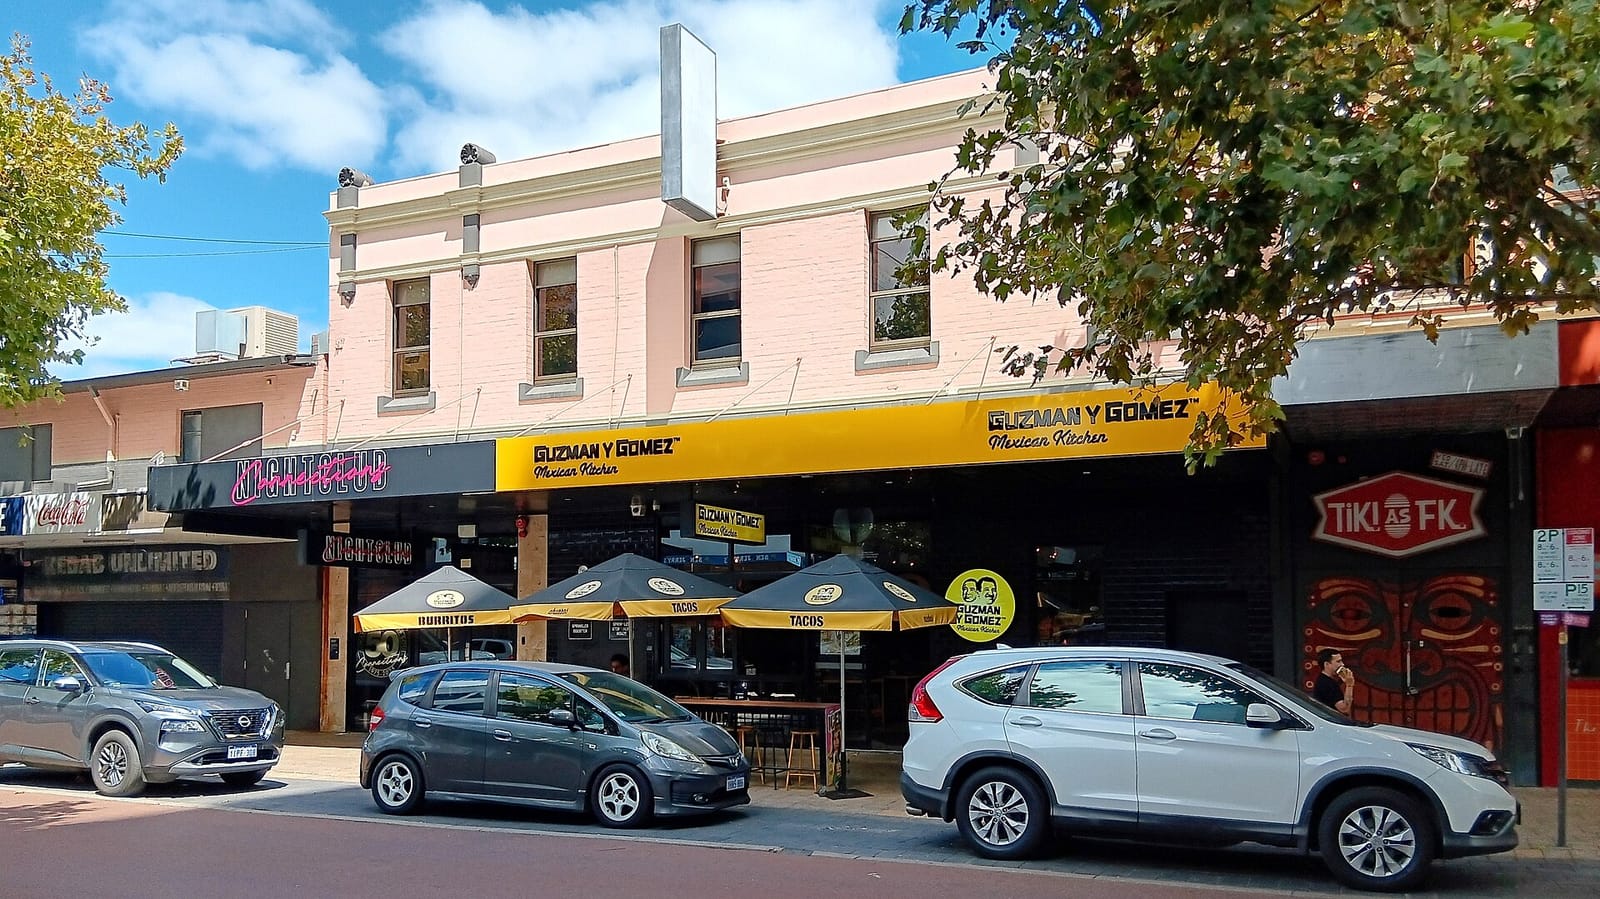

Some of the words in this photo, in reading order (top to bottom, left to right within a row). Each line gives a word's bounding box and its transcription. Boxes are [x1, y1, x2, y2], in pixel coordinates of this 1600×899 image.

[988, 406, 1081, 431] GUZMAN
[1085, 404, 1101, 425] Y
[989, 434, 1049, 450] Mexican
[1053, 429, 1108, 445] Kitchen
[534, 443, 600, 463] GUZMAN
[602, 441, 614, 458] Y
[534, 465, 577, 479] Mexican
[580, 462, 618, 476] Kitchen
[231, 456, 392, 505] Connections
[698, 505, 729, 524] GUZMAN
[729, 511, 736, 525] Y
[1386, 508, 1411, 524] AS
[1537, 530, 1559, 542] 2P
[110, 550, 217, 573] UNLIMITED
[671, 602, 698, 613] TACOS
[957, 605, 1000, 615] GUZMAN
[418, 615, 474, 626] BURRITOS
[790, 615, 824, 627] TACOS
[957, 615, 964, 624] Y
